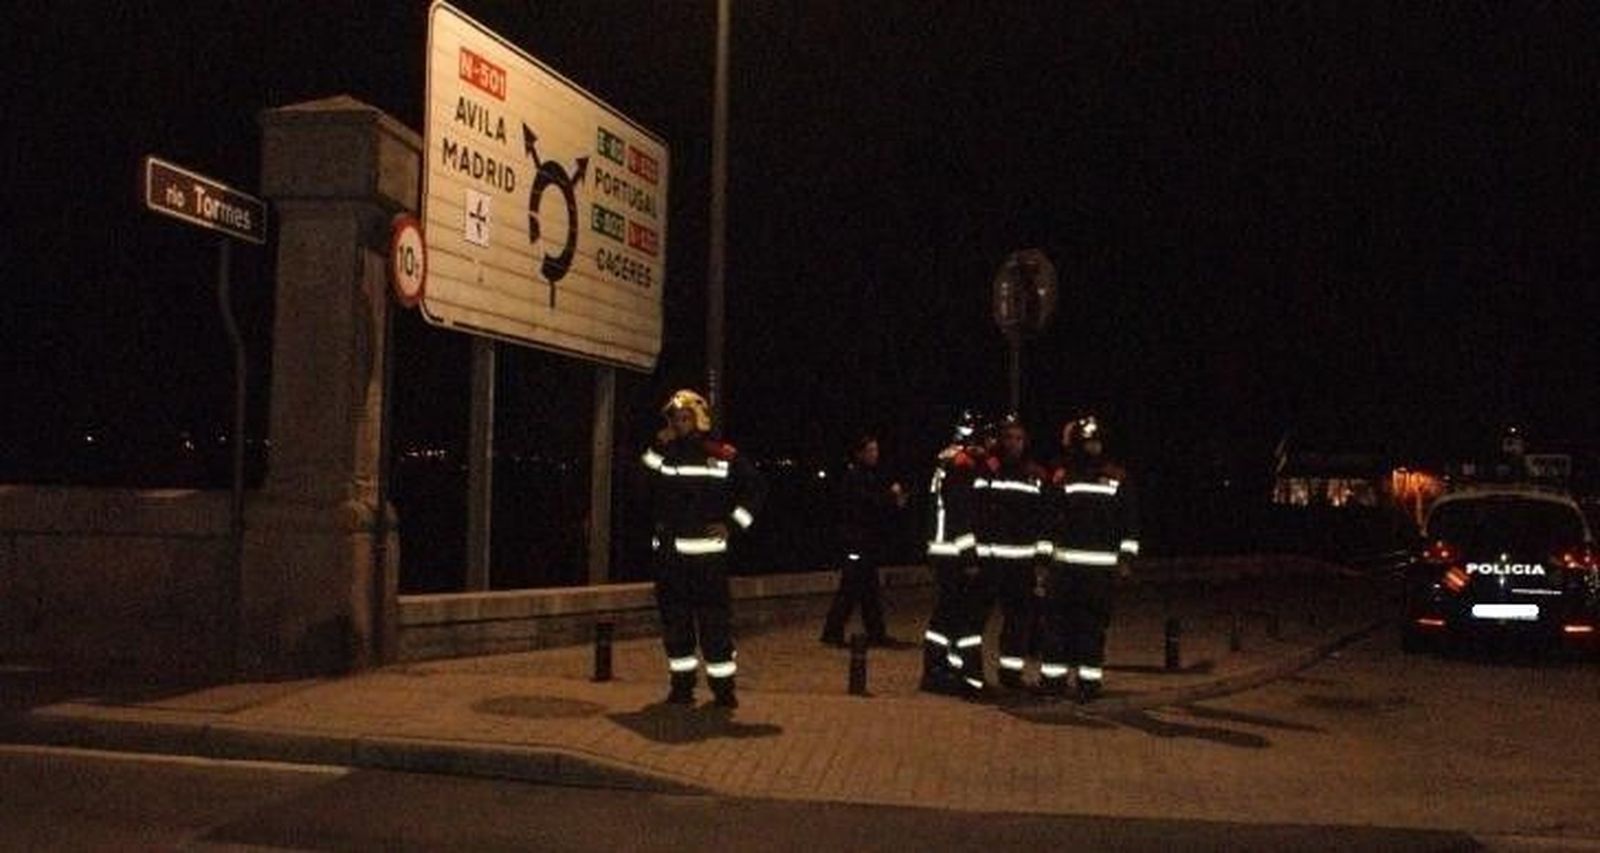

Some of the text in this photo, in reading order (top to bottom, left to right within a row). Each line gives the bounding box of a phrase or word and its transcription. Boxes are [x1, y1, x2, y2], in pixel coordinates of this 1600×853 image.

[459, 51, 506, 97] N-501
[455, 96, 506, 145] AVILA
[442, 138, 515, 193] MADRID
[194, 184, 251, 230] Tormes
[595, 167, 657, 219] PORTUGAL
[1465, 563, 1546, 575] POLICIA
